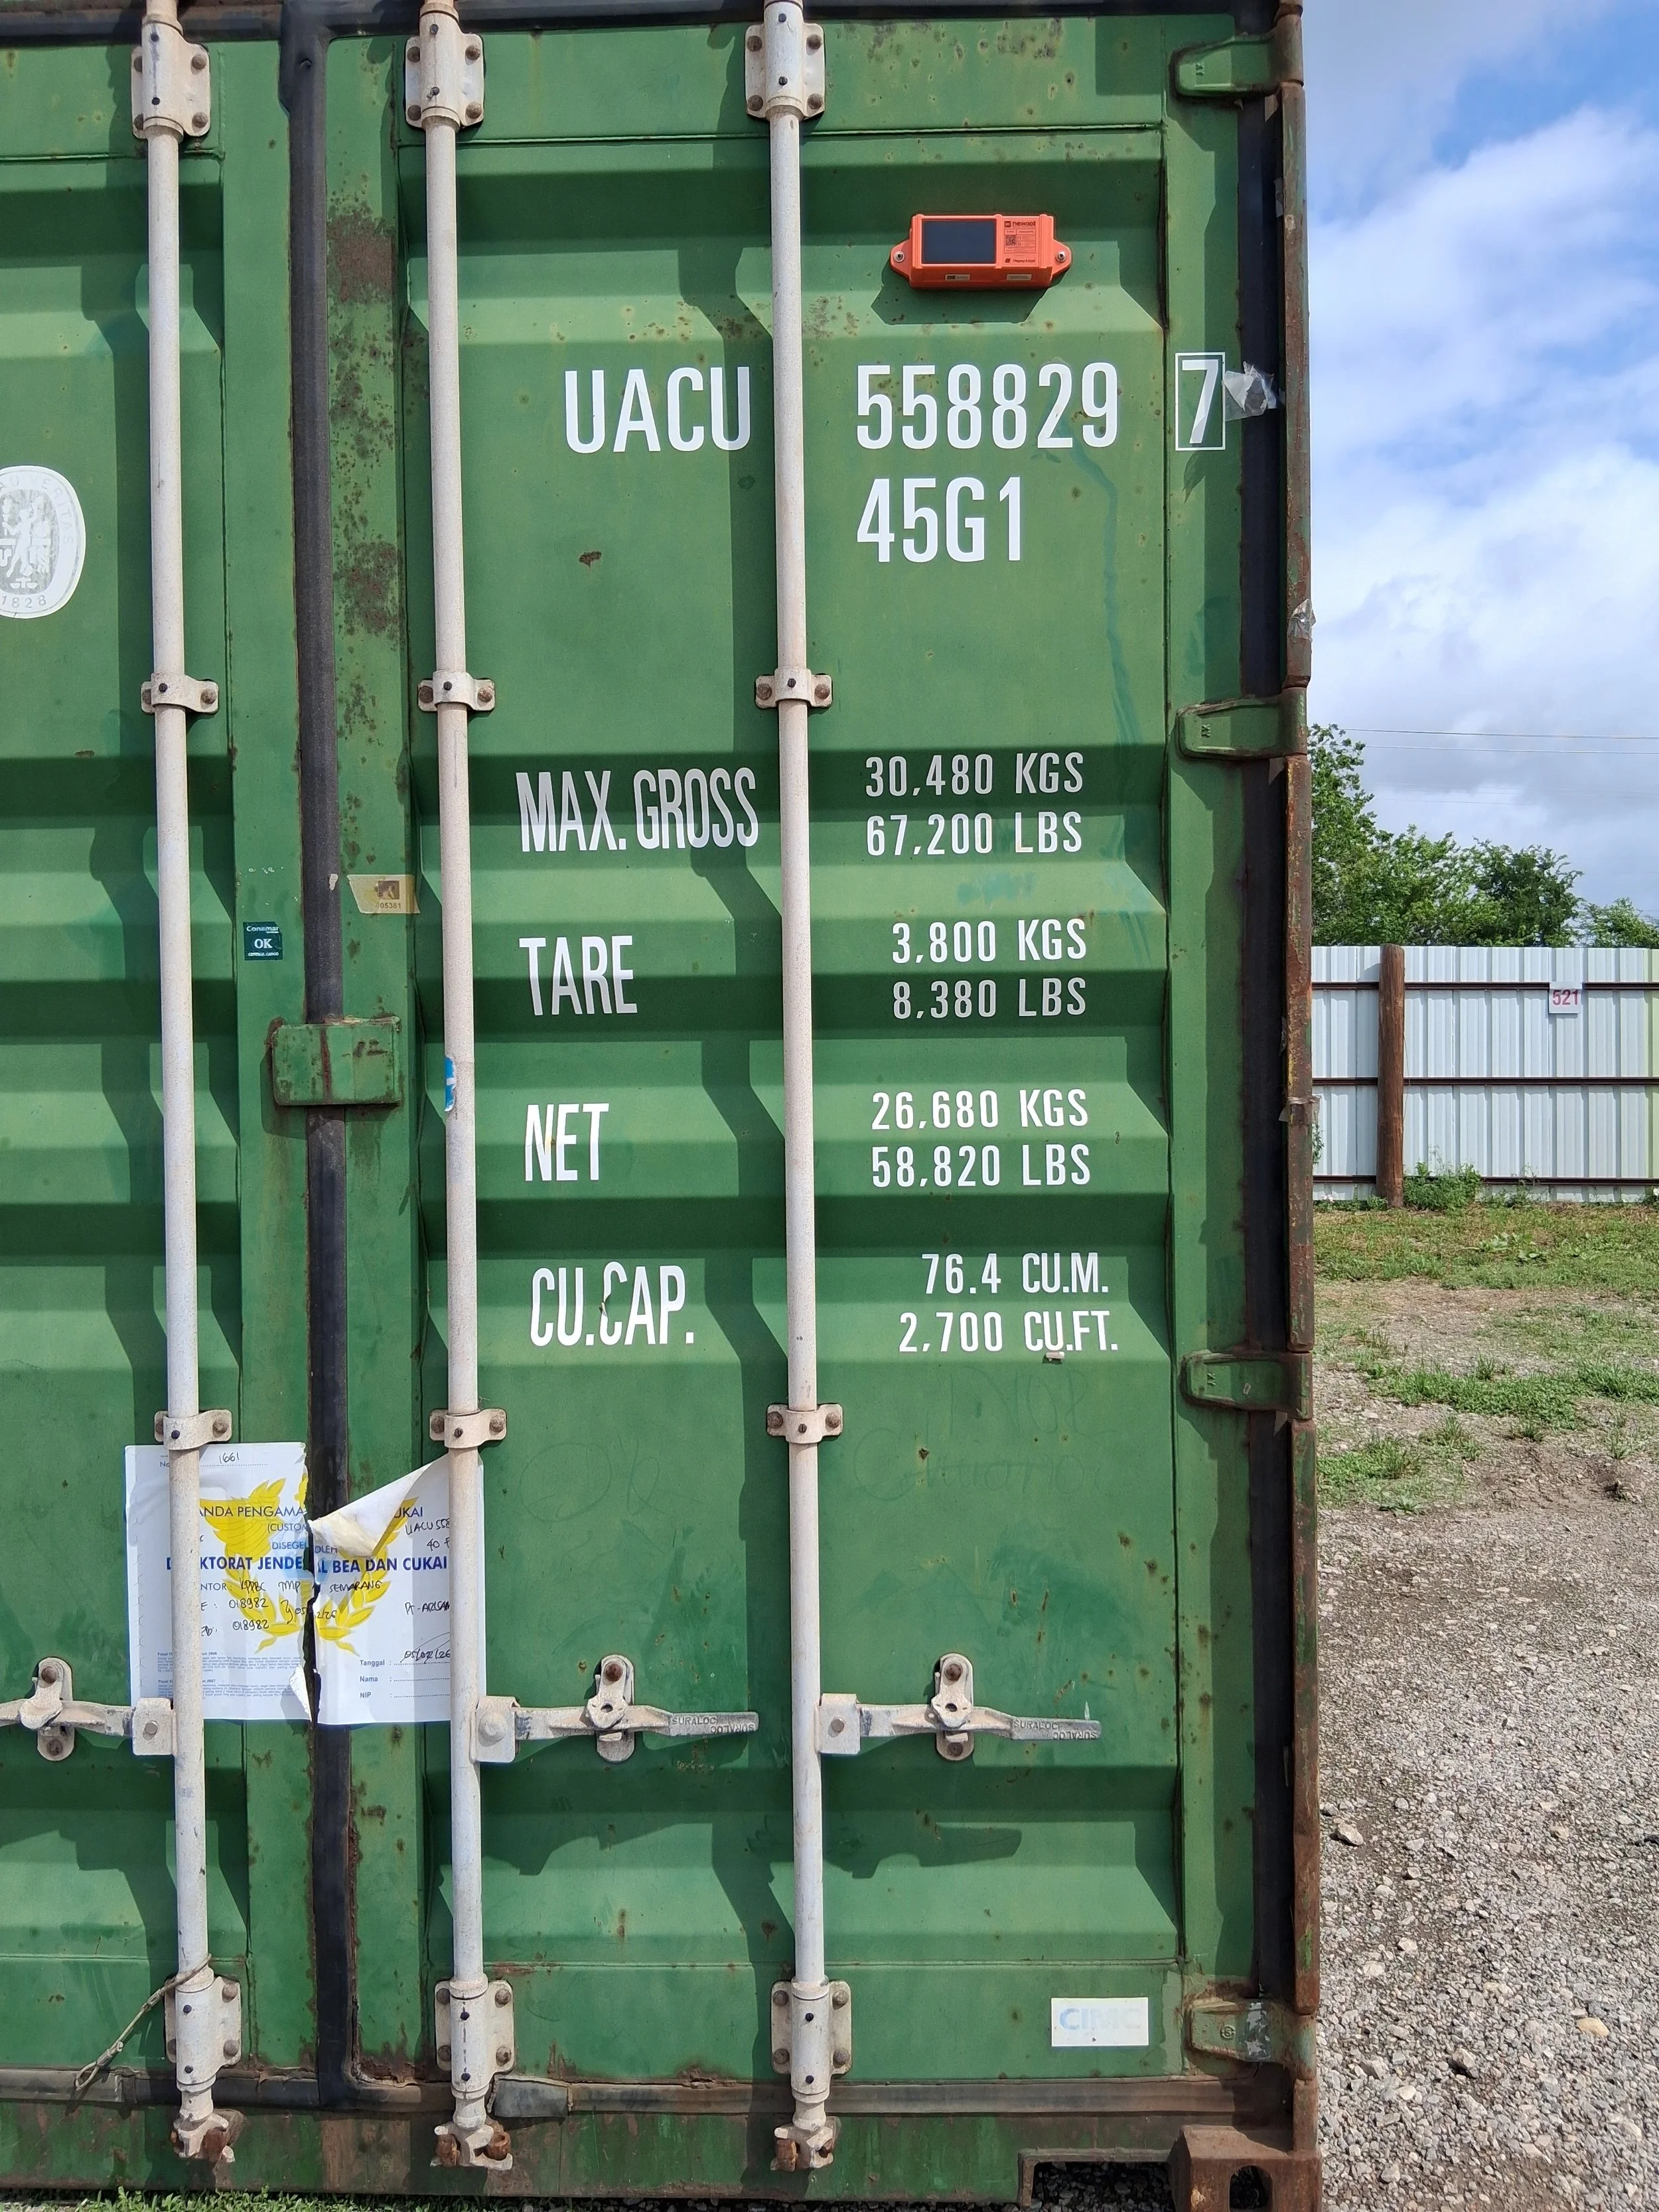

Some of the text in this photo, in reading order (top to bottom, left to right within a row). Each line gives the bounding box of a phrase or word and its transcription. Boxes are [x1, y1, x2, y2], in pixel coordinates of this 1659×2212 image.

[565, 360, 1219, 454] UACU 558829 7
[857, 475, 1022, 563] 45G1
[1, 595, 47, 609] 1828
[866, 752, 1084, 797] 30,480 KGS
[516, 767, 758, 852] MAX. GROSS
[867, 811, 1082, 856] 67,200 LBS
[254, 938, 273, 948] OK
[892, 918, 1087, 964] 3,800 KGS
[518, 935, 638, 1016] TARE
[893, 977, 1086, 1019] 8,380 LBS
[1552, 989, 1579, 1005] 521
[871, 1088, 1088, 1130] 26,680 KGS
[524, 1102, 610, 1181] NET
[872, 1143, 1091, 1188] 58,820 LBS
[922, 1252, 1109, 1295] 76.4 CU.M.
[530, 1261, 694, 1347] CU.CAP.
[899, 1310, 1119, 1353] 2,700 CU.FT.
[219, 1451, 240, 1464] 1661
[200, 1505, 304, 1517] NDA PENGAMA
[394, 1507, 423, 1518] UKAI
[332, 1560, 360, 1574] BEA
[366, 1558, 397, 1571] DAN
[402, 1556, 447, 1571] CUKAI
[426, 1538, 440, 1551] 40
[329, 1582, 382, 1593] SEMARANG
[671, 1716, 717, 1726] SURALOC
[1013, 1720, 1058, 1730] SURALOC
